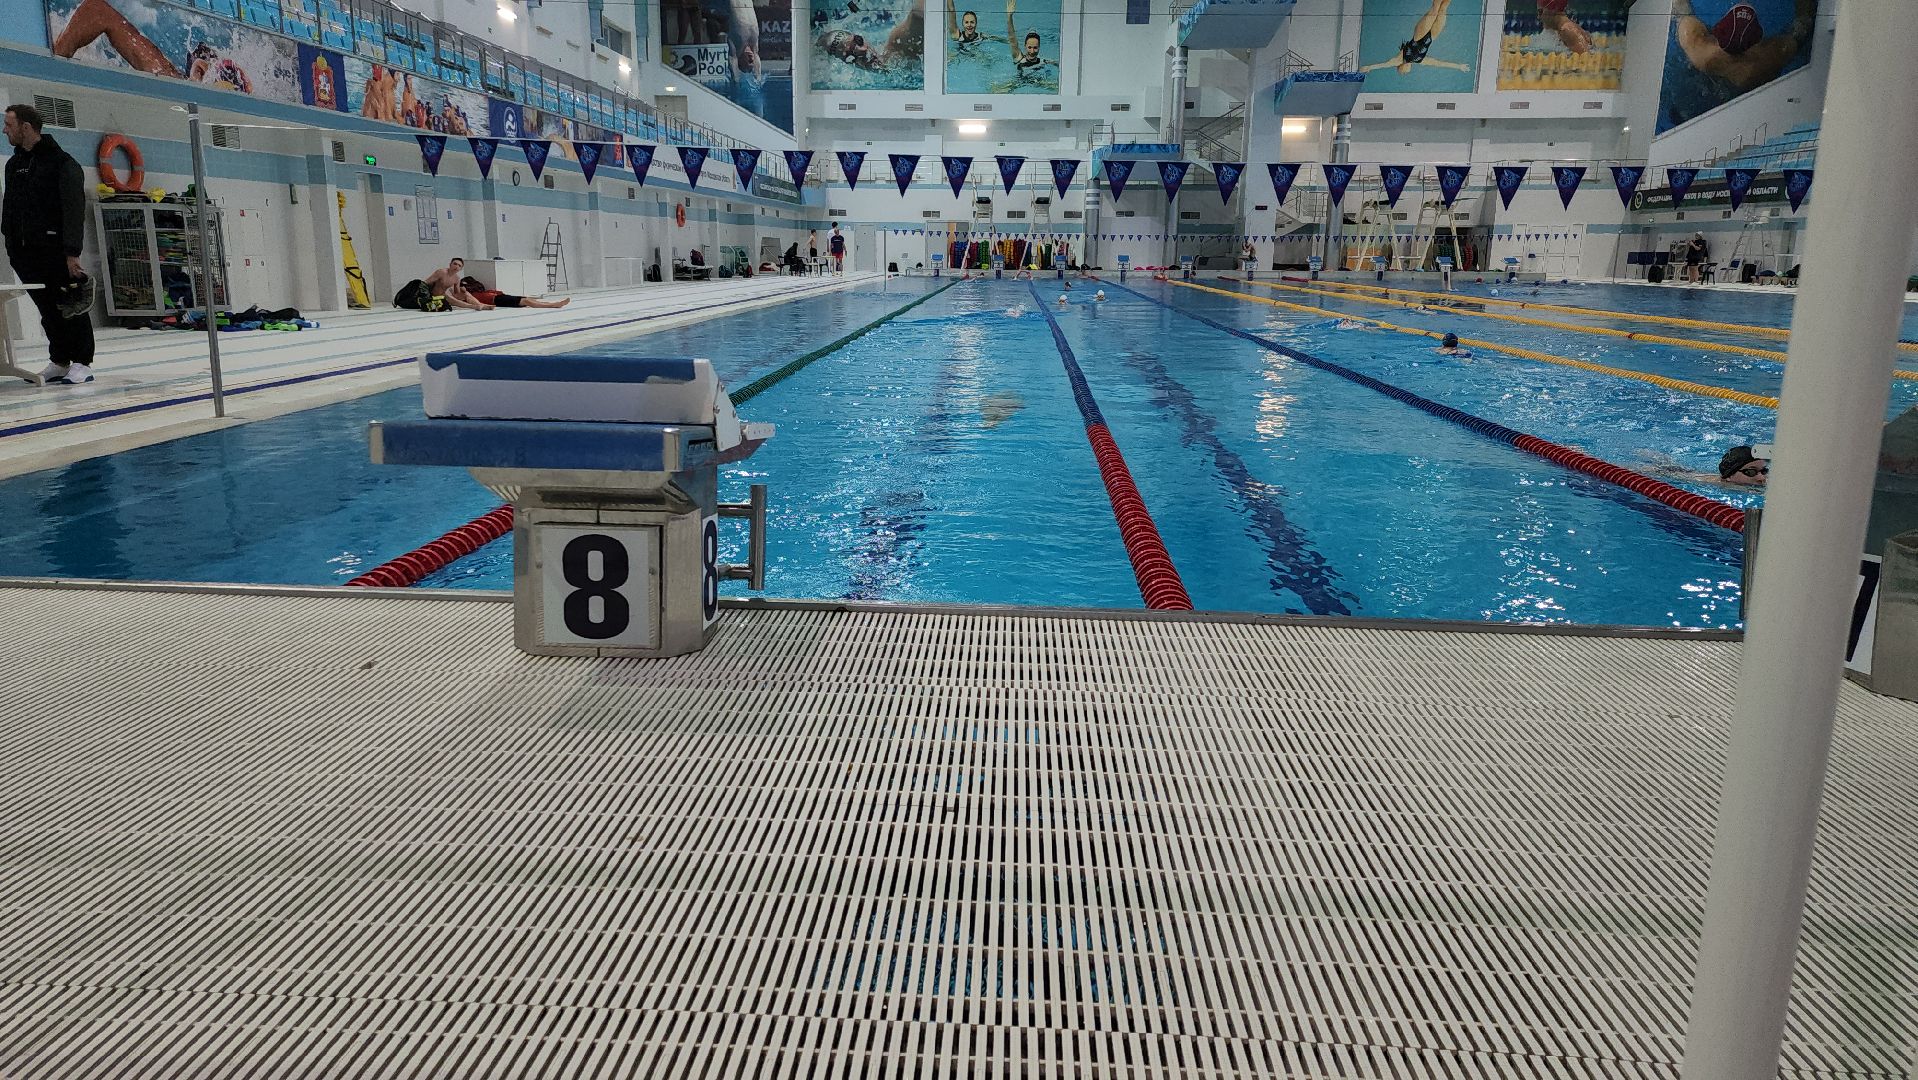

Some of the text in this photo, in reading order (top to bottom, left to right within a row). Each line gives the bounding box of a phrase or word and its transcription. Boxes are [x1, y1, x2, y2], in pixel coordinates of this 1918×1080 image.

[761, 20, 791, 33] KAZ
[697, 48, 728, 64] Myrt
[698, 62, 727, 75] Pool
[1752, 186, 1779, 195] ОБЛАСТИ
[703, 520, 719, 621] 8
[562, 534, 630, 640] 8
